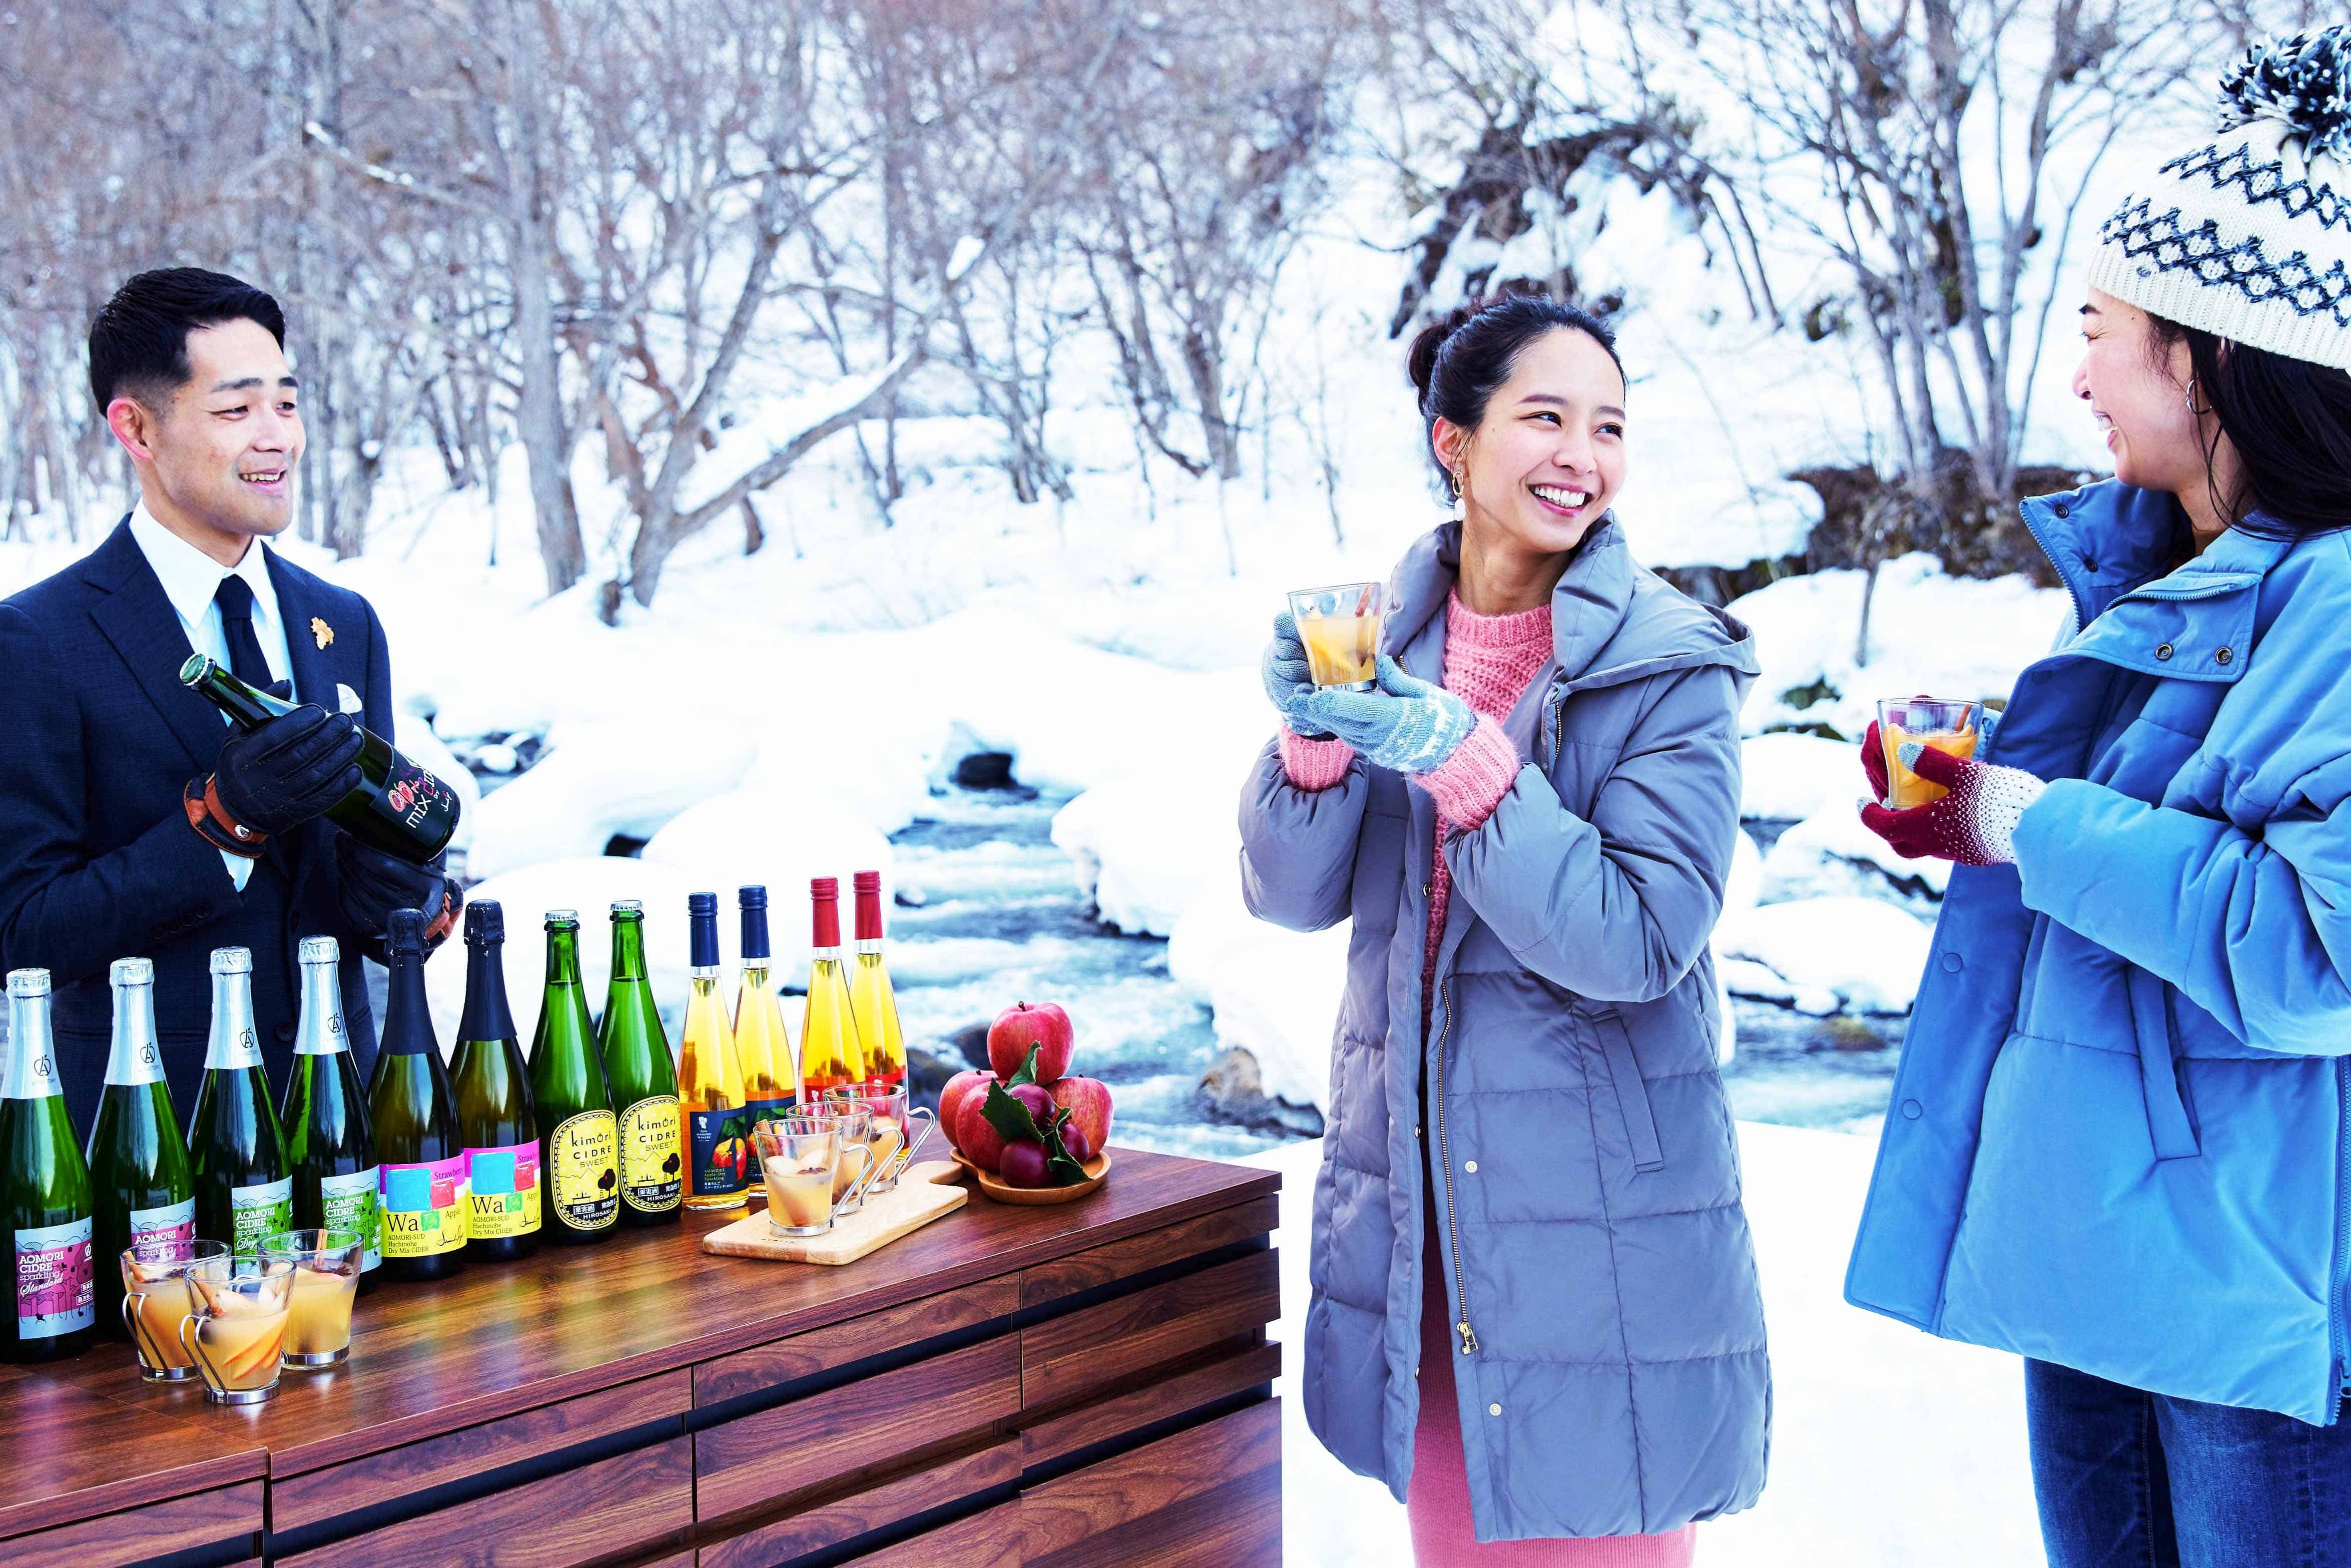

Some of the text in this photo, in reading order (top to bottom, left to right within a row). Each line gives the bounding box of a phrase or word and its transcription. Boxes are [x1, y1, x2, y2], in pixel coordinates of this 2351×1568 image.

[640, 1130, 676, 1143] CIDRE
[573, 1145, 612, 1160] CIDRE
[645, 1141, 674, 1151] SWEET
[579, 1157, 609, 1168] SWEET
[326, 1196, 363, 1209] AOMORI
[647, 1193, 675, 1202] HIROSAKI
[326, 1205, 355, 1218] CIDRE
[471, 1197, 504, 1214] Wa
[236, 1207, 275, 1221] AOMORI
[326, 1214, 361, 1225] sparkling
[445, 1208, 461, 1219] Apple
[583, 1209, 612, 1219] HIROSAKI
[236, 1218, 267, 1229] CIDRE
[387, 1214, 419, 1232] Wa
[134, 1230, 177, 1245] AOMORI
[236, 1226, 272, 1237] sparkling
[236, 1236, 257, 1250] Dry
[19, 1251, 65, 1264] AOMORI
[20, 1263, 53, 1274] CIDRE
[20, 1270, 61, 1281] sparkling
[20, 1272, 64, 1297] Standard
